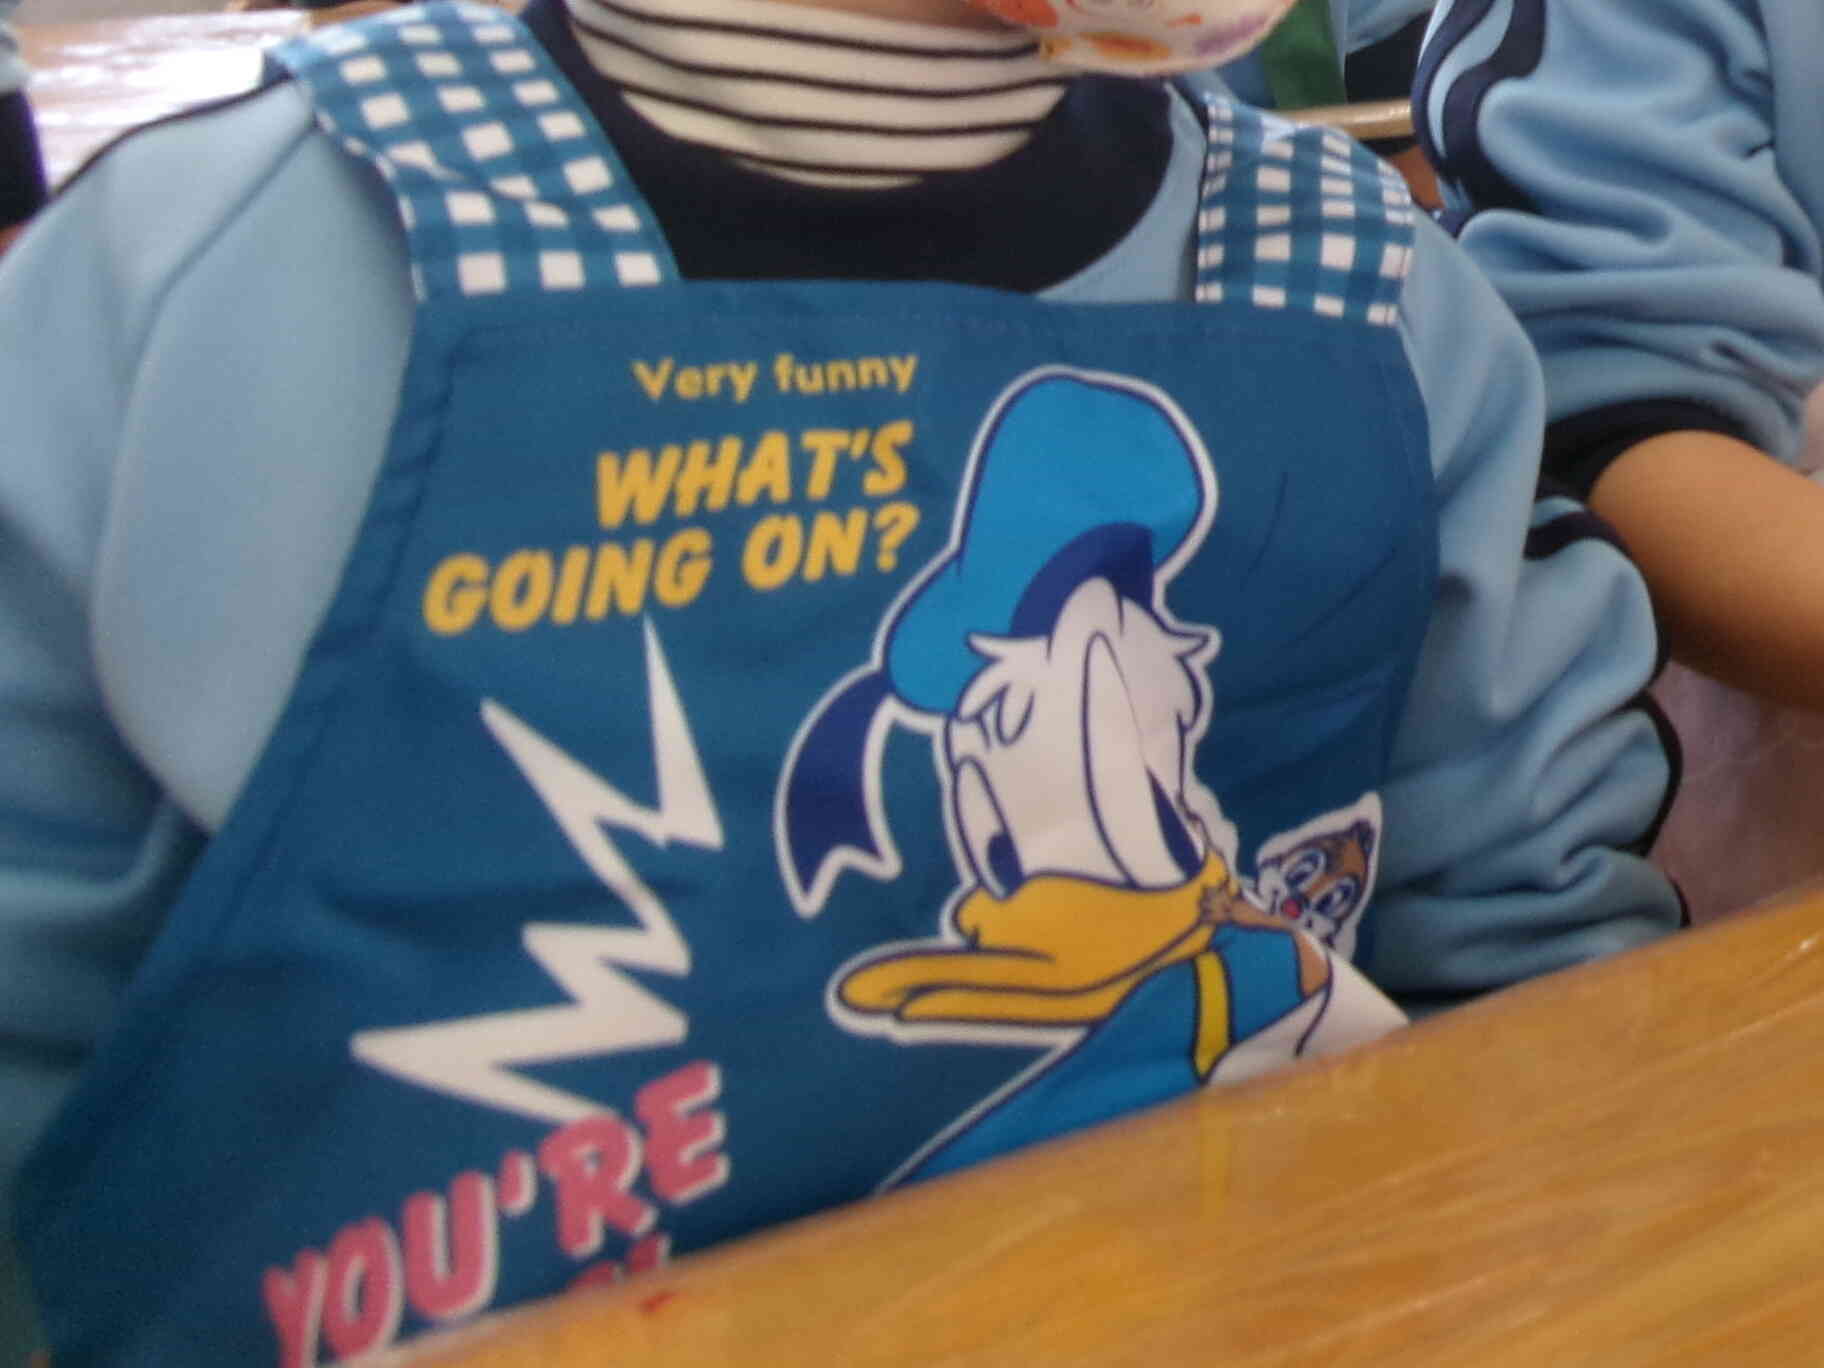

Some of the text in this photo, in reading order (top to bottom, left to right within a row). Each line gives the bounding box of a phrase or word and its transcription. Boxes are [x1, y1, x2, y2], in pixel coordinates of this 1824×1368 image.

[630, 351, 918, 404] Very funny
[598, 421, 912, 525] WHAT'S
[422, 500, 921, 635] GOING ON?
[262, 1058, 732, 1368] YOU'RE
